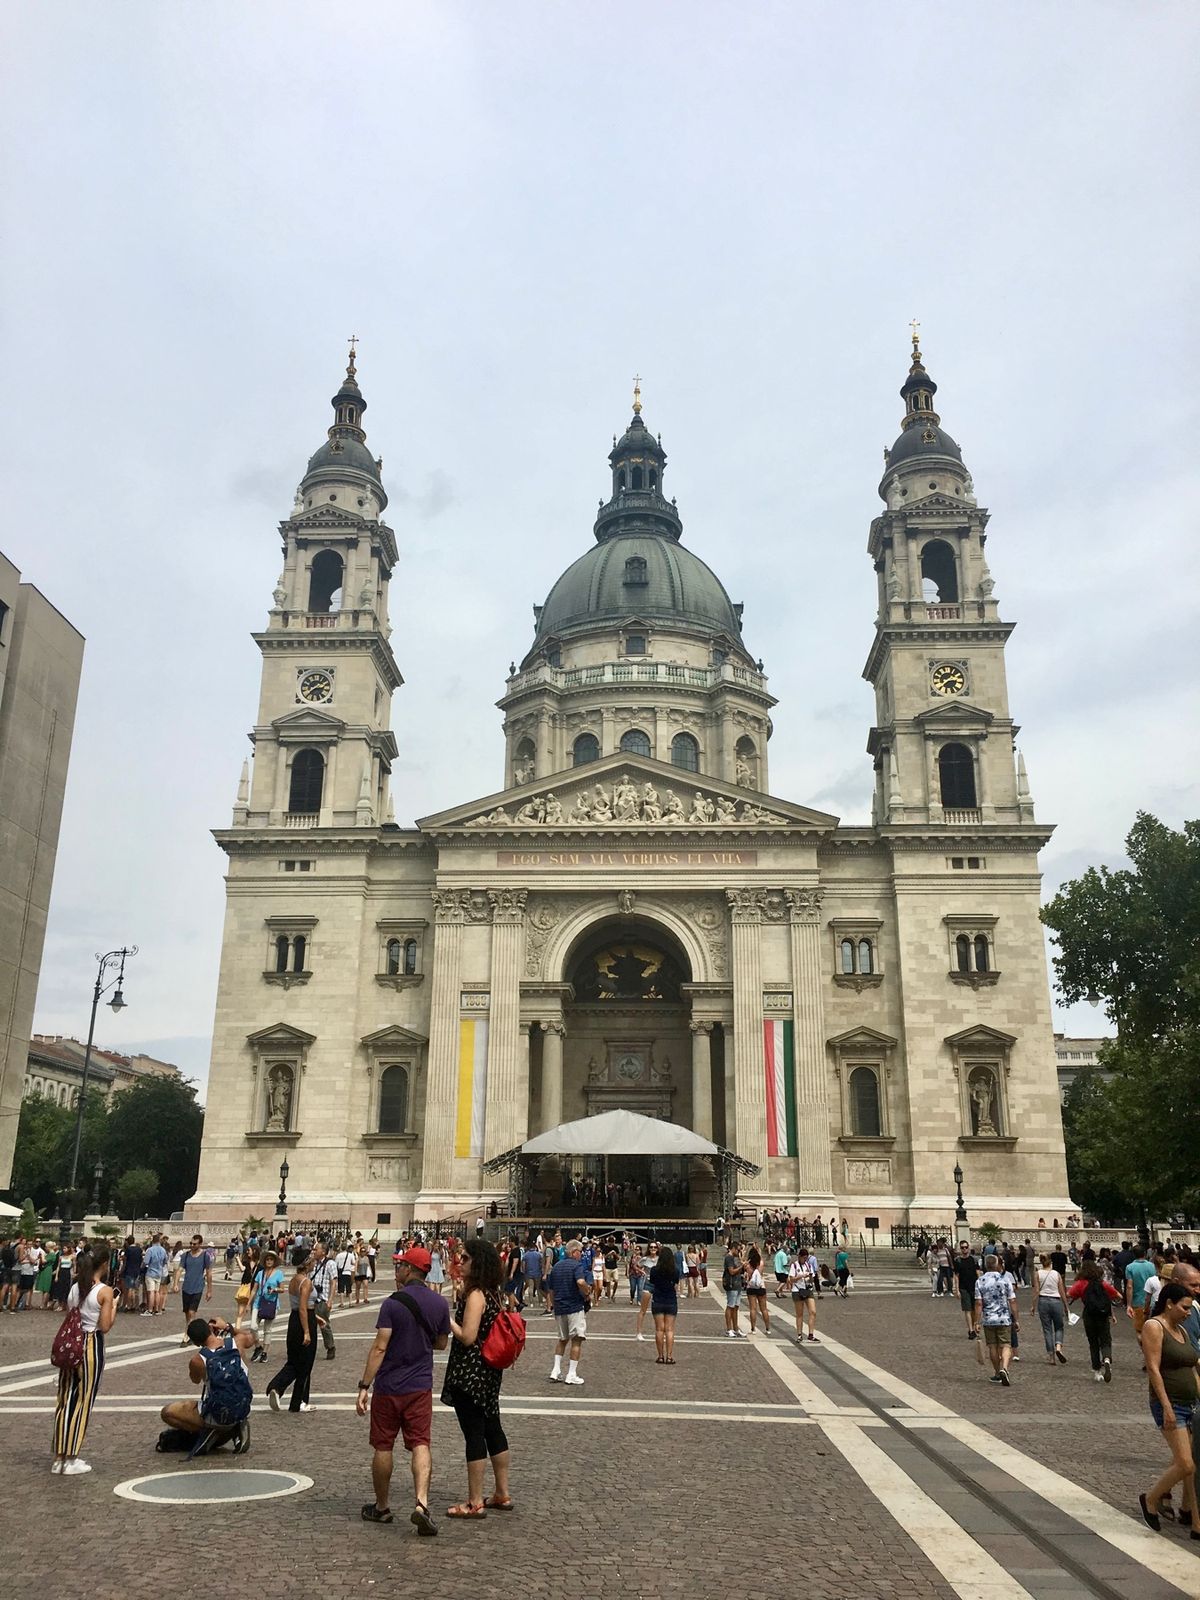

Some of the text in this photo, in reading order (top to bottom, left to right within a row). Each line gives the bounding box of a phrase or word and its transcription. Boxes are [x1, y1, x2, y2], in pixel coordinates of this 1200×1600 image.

[512, 853, 743, 866] EGO SUM VIA VERITAS ET VITA
